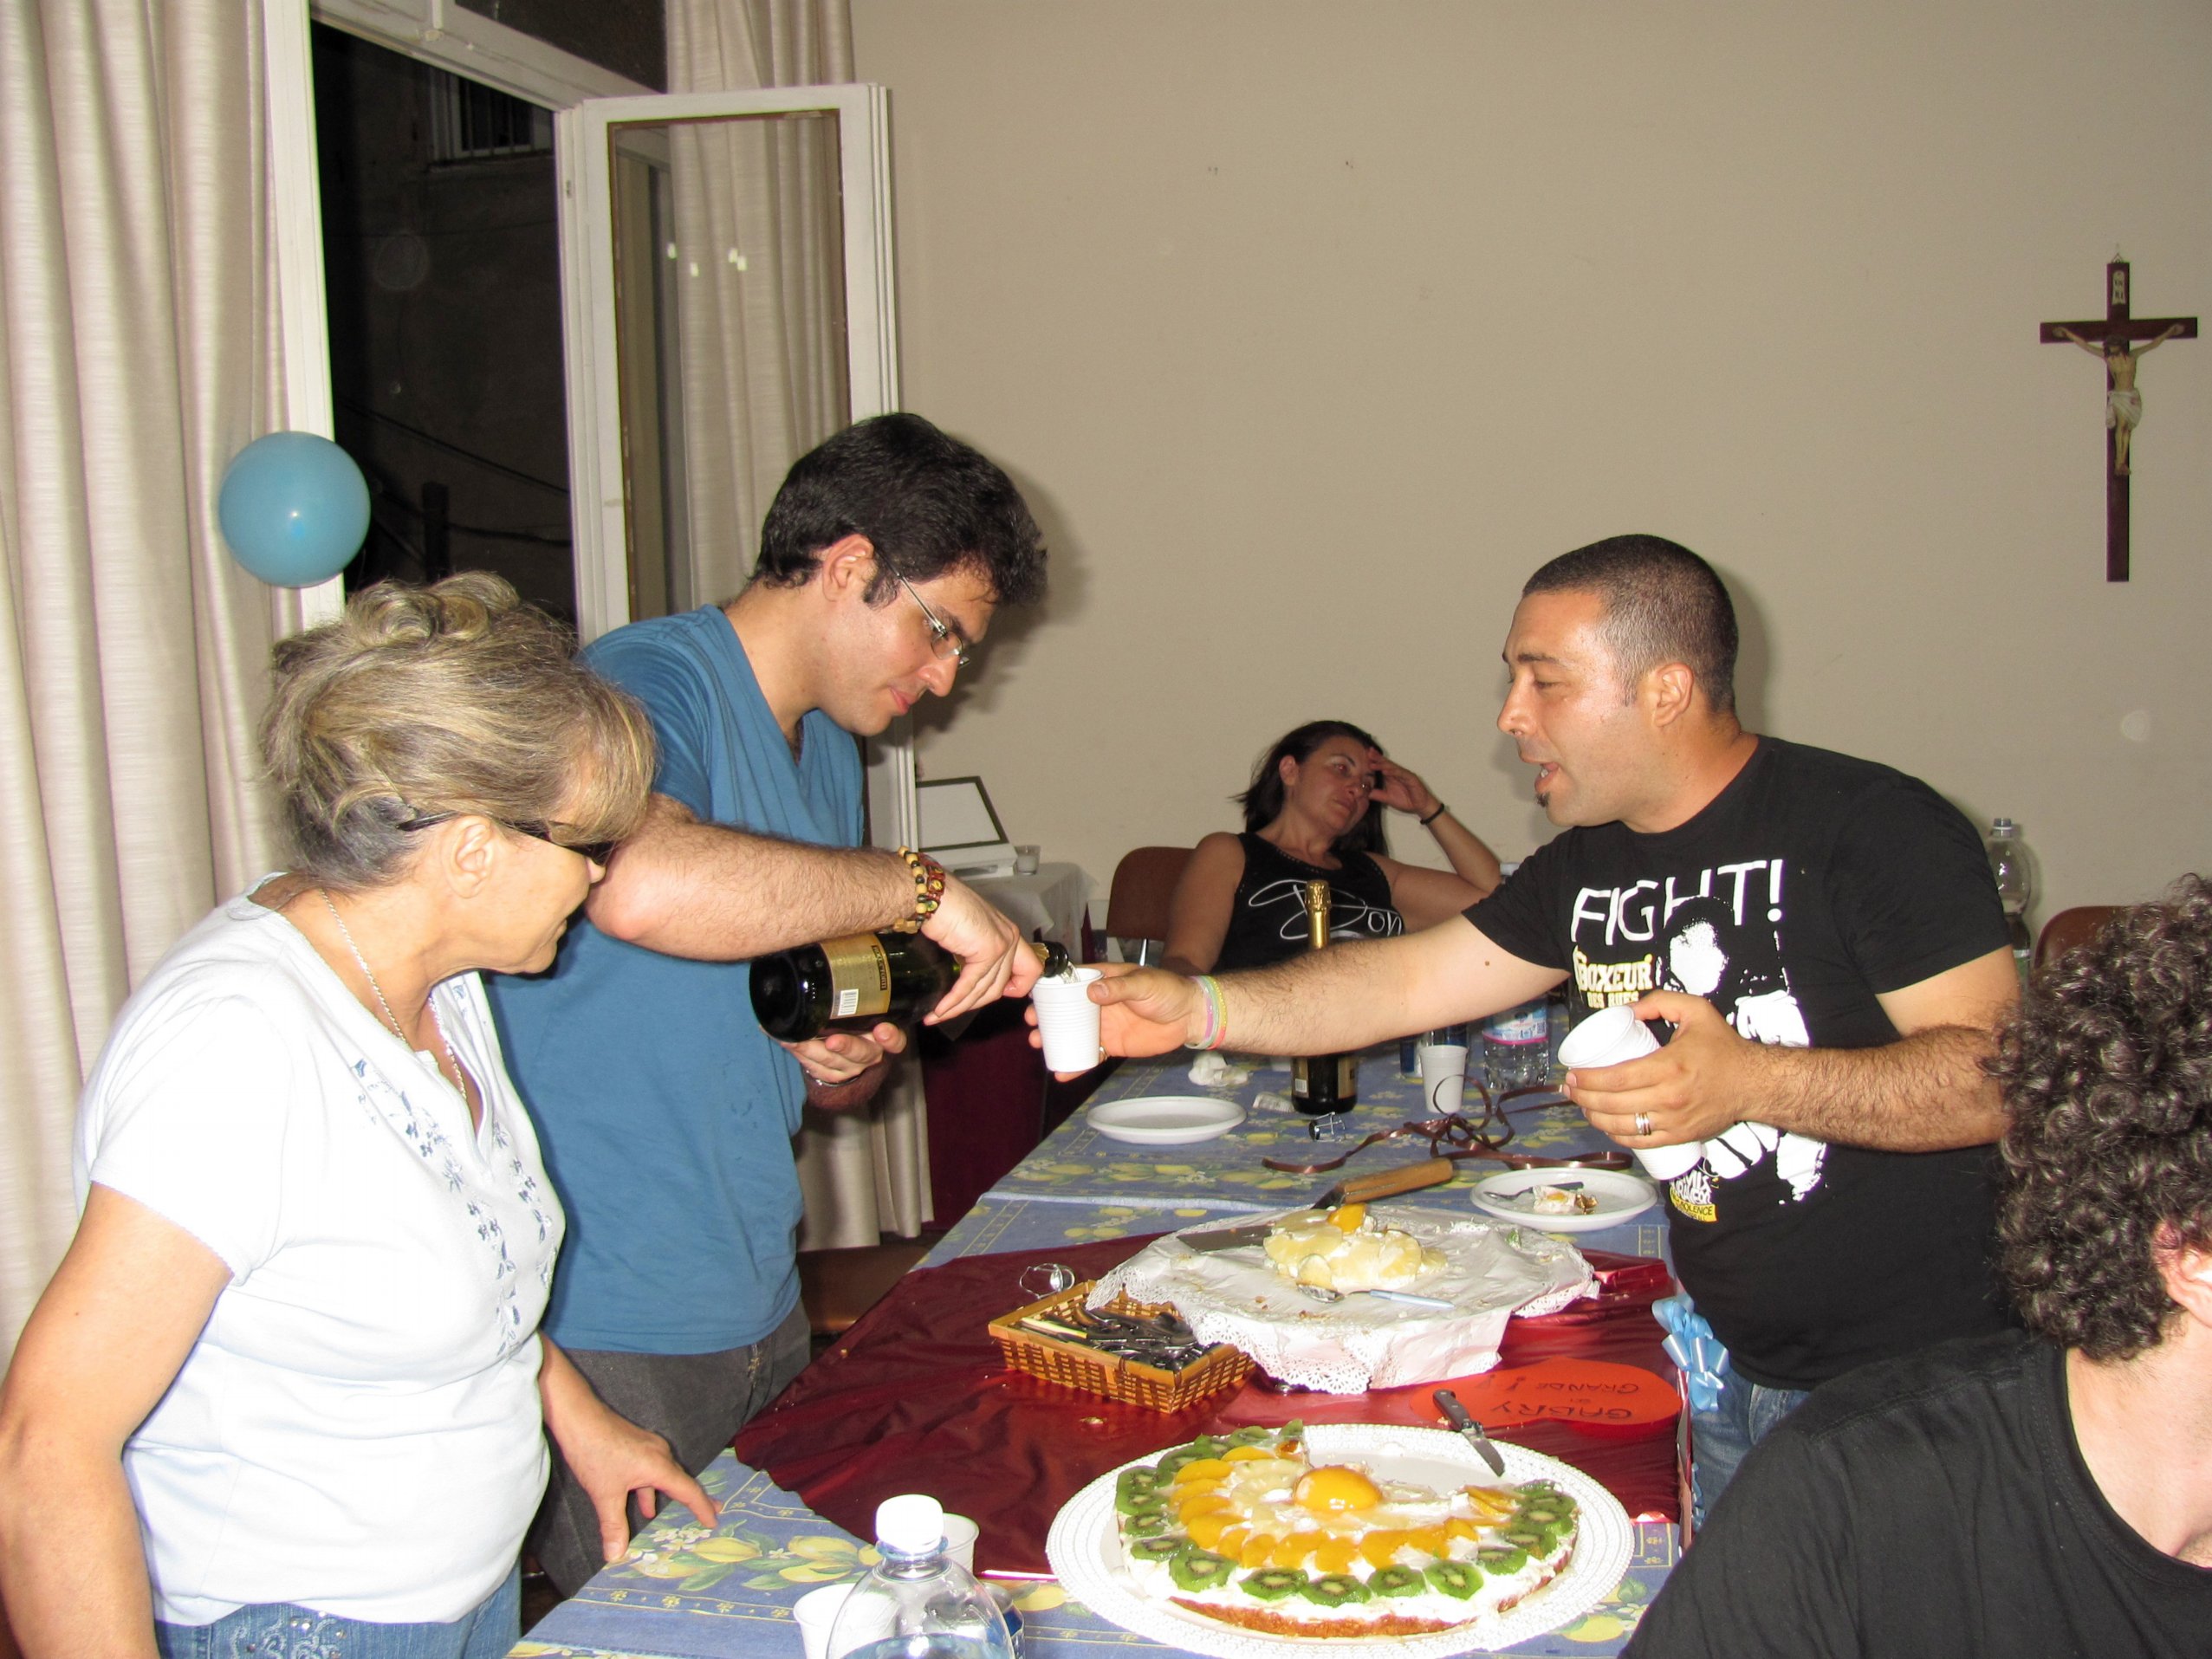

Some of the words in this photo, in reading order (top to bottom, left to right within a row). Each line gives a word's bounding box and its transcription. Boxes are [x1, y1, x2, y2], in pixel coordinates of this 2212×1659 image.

[1570, 859, 1783, 946] FIGHT!
[1574, 951, 1653, 993] BOXEUR
[1490, 1400, 1632, 1421] GABRY
